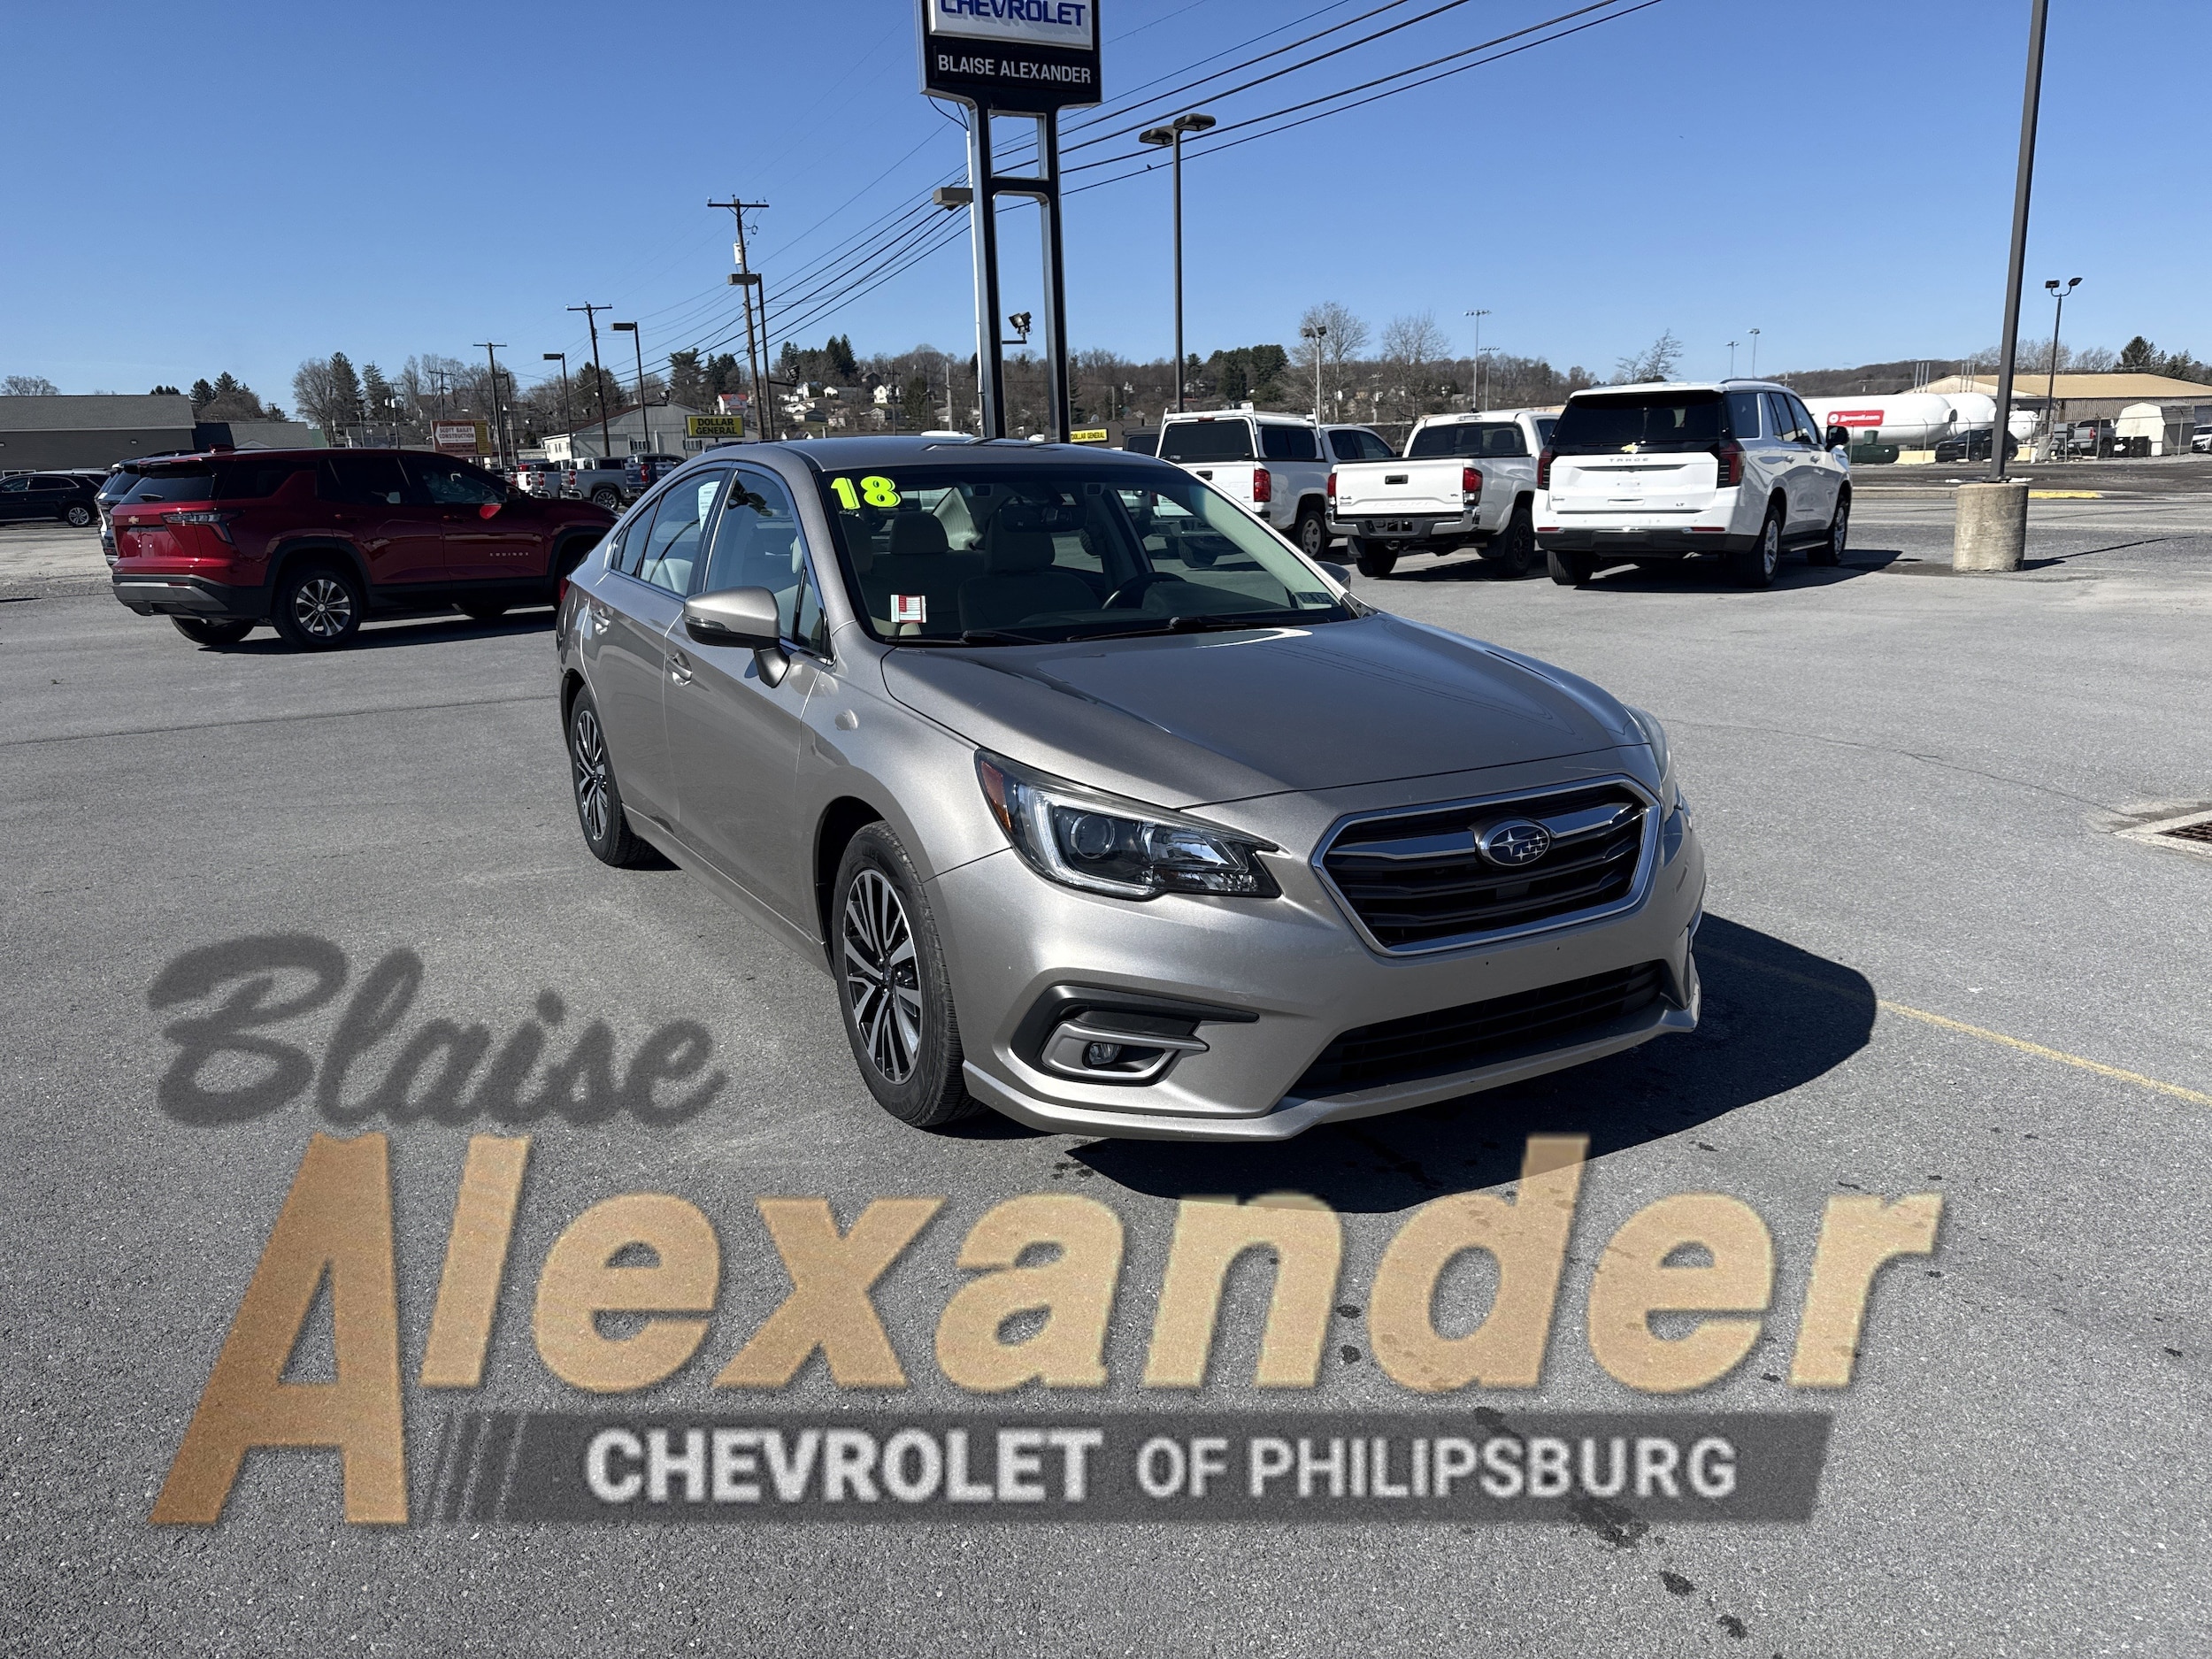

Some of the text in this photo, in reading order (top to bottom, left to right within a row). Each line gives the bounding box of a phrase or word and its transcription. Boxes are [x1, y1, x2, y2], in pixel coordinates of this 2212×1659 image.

[938, 54, 1091, 84] BLAISE ALEXANDER
[831, 476, 902, 510] 18
